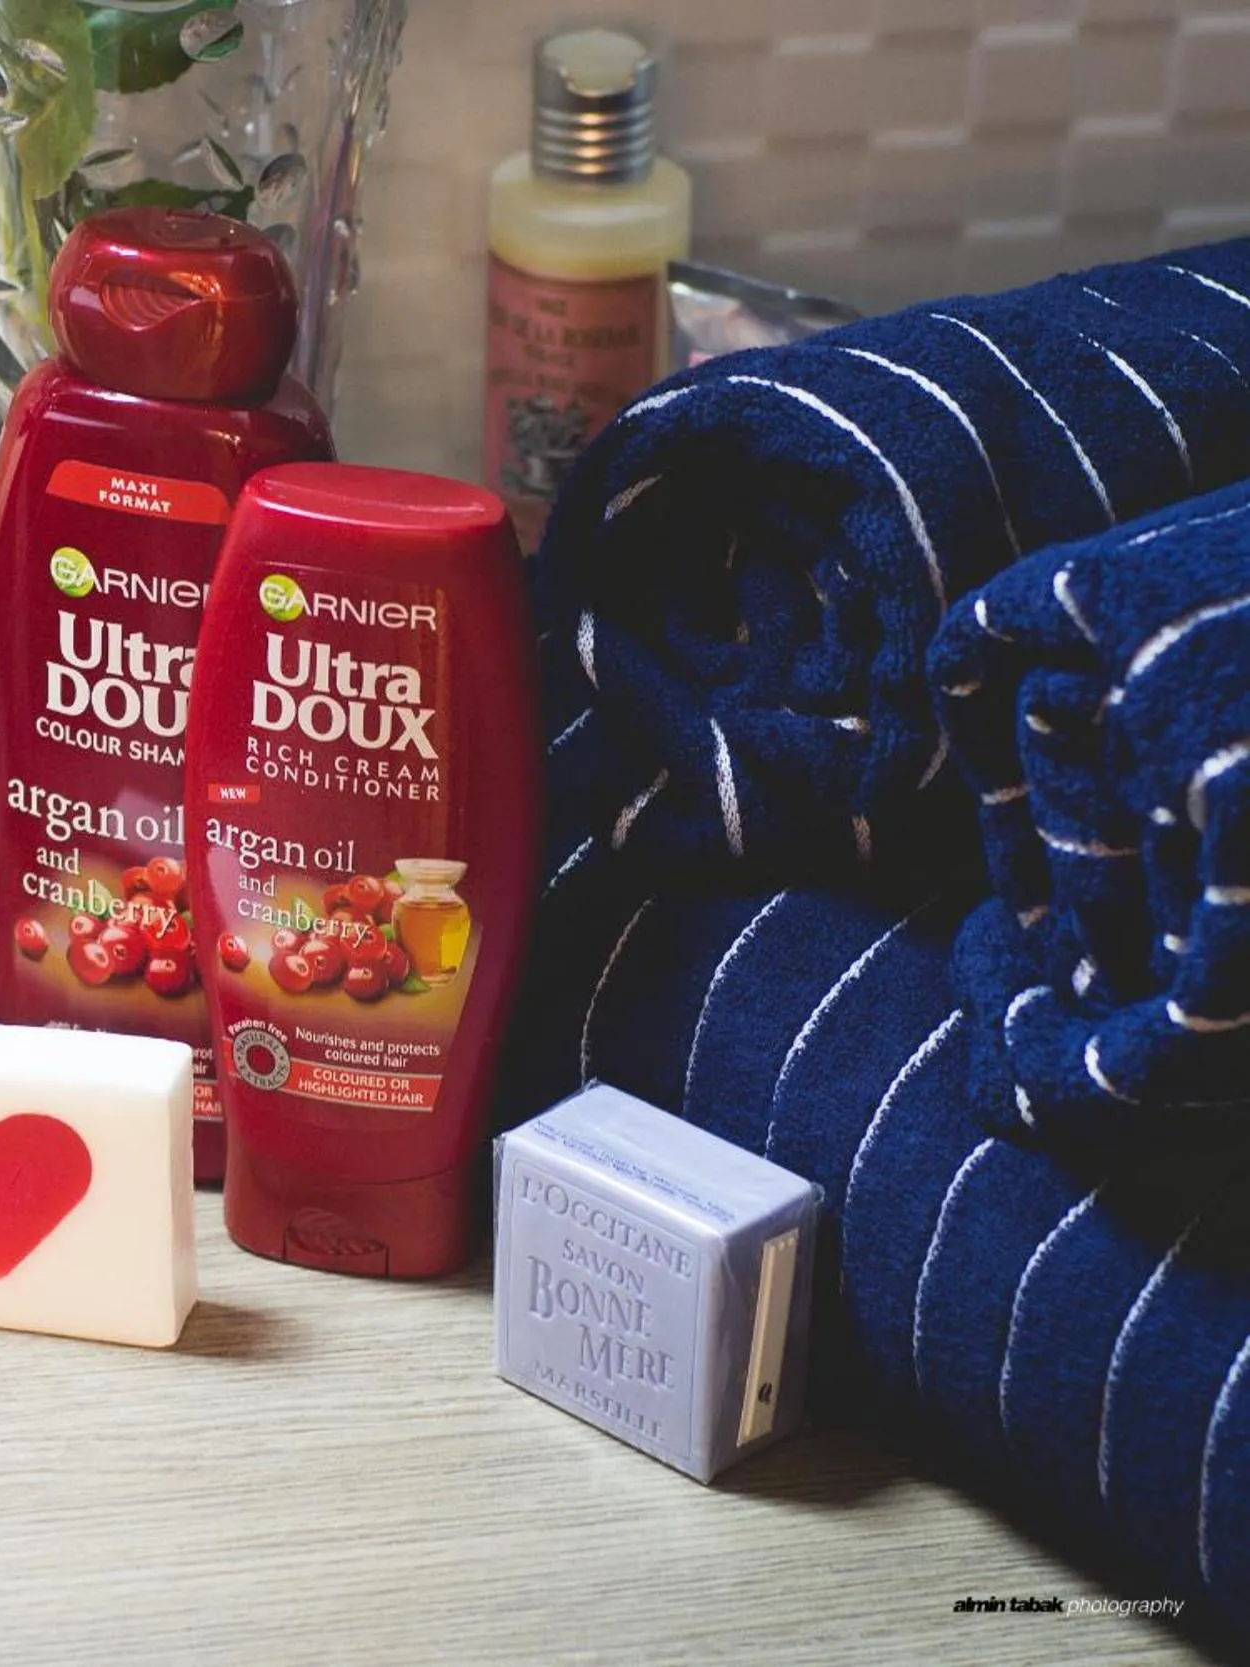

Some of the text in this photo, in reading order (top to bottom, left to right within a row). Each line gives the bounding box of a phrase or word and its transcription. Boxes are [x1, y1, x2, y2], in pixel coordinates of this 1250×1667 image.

[99, 490, 171, 514] FORMAT
[111, 477, 158, 495] MAXI
[51, 556, 210, 608] GARNIE
[259, 581, 437, 631] GARNIER
[266, 632, 422, 704] Ultra
[46, 661, 191, 737] DOU
[251, 680, 439, 759] DOUX
[36, 716, 122, 757] COLOUR
[247, 736, 439, 782] RICH CREAM
[220, 787, 246, 799] NEW
[246, 755, 439, 801] CONDITIONER
[7, 778, 185, 844] argan oil
[36, 847, 81, 875] and
[206, 818, 355, 873] argan oil
[22, 872, 177, 938] cranberry
[238, 875, 275, 897] and
[237, 898, 370, 948] cranberry
[268, 1023, 288, 1042] free
[295, 1027, 440, 1057] Nourishes and protects
[313, 1068, 409, 1091] COLOURED OR
[325, 1049, 408, 1068] coloured hair
[298, 1079, 424, 1104] HIGHLIGHTED HAIR
[520, 1176, 693, 1279] L'OCCITANE
[563, 1239, 645, 1294] SAVON
[528, 1255, 652, 1338] BONNE
